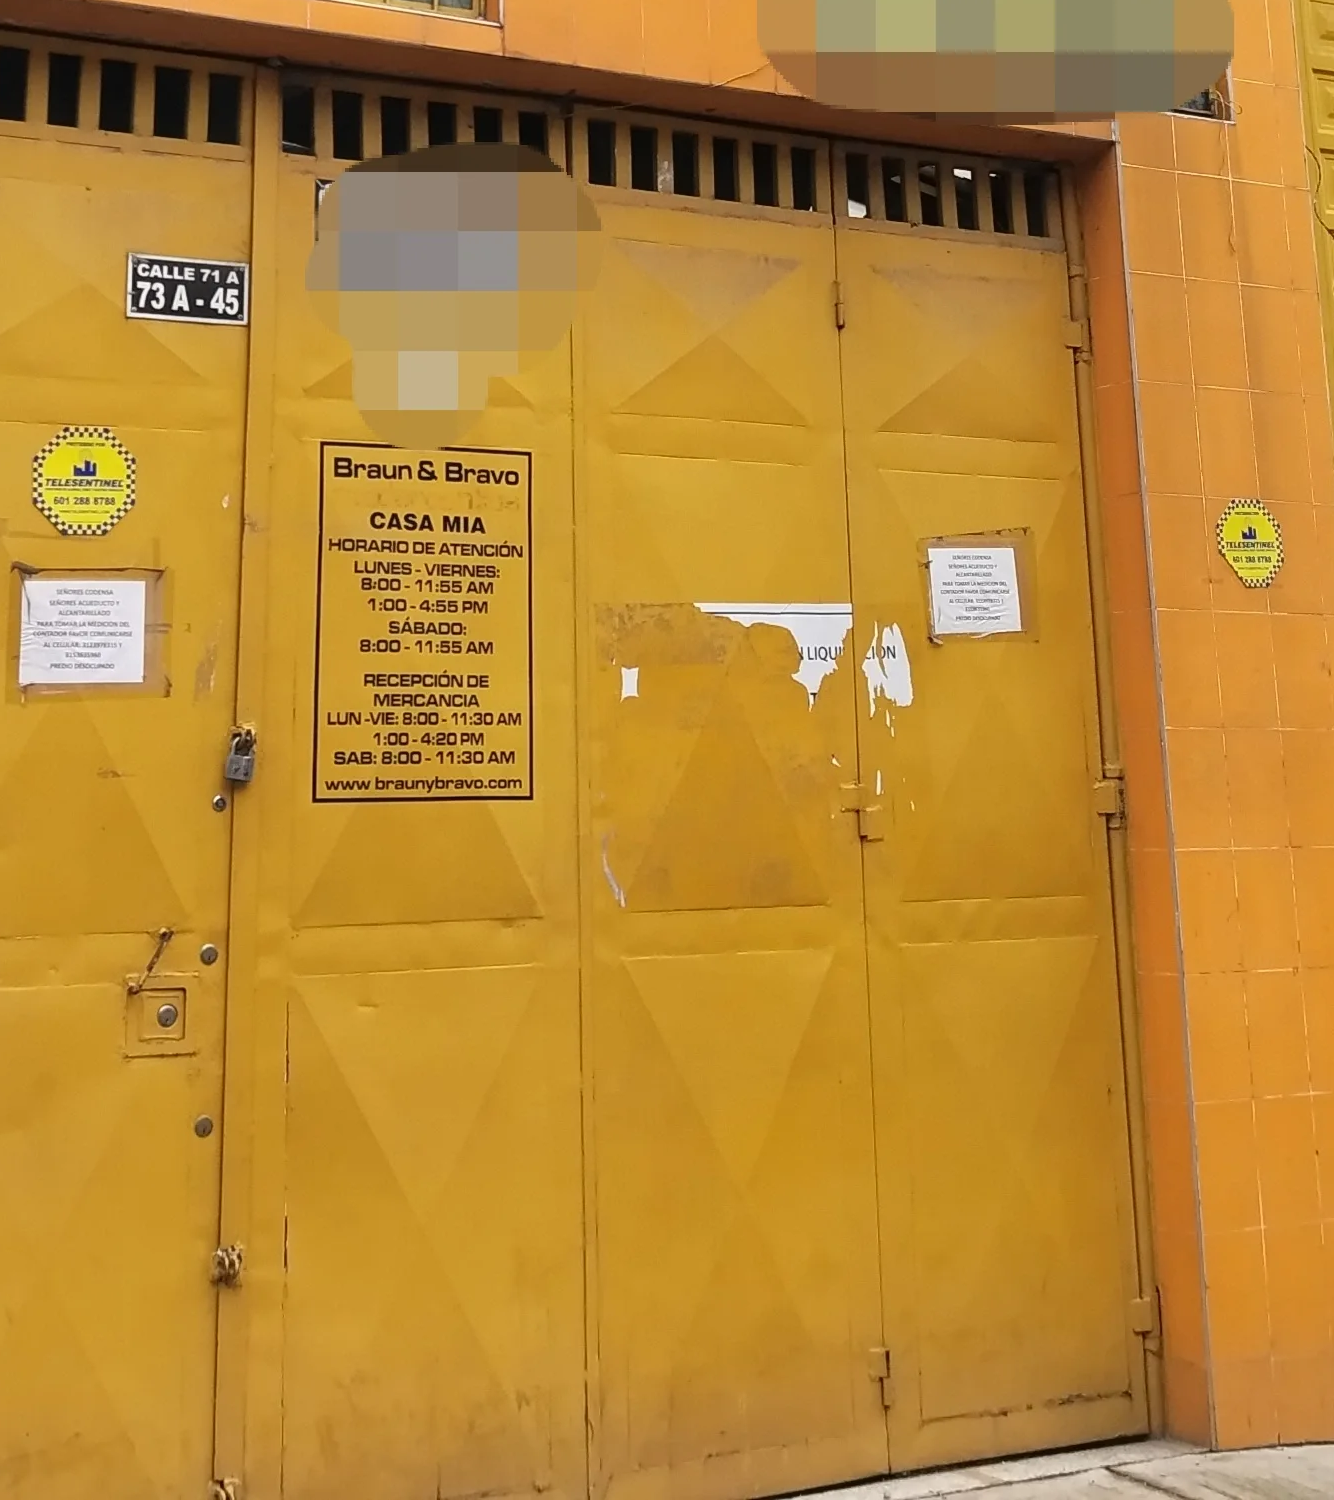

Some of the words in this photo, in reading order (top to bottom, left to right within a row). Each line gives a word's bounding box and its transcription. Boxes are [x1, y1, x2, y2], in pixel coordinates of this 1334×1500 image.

[137, 263, 195, 281] CALLE
[200, 268, 220, 283] 71
[226, 271, 240, 284] A
[136, 281, 165, 310] 73
[171, 284, 190, 312] A
[210, 287, 239, 315] 45
[334, 457, 412, 480] Braun
[417, 460, 438, 481] &
[445, 462, 520, 485] Bravo
[44, 478, 124, 487] TELESENTINEL
[370, 511, 434, 532] CASA
[442, 515, 486, 534] MIA
[328, 538, 409, 554] HORARIO
[413, 541, 435, 555] DE
[438, 540, 523, 558] ATENCIÓN
[354, 560, 412, 575] LUNES
[424, 563, 500, 578] VIERNES:
[361, 577, 401, 591] 8:00
[415, 580, 462, 593] 11:55
[466, 581, 494, 595] AM
[367, 598, 407, 612] 1:00
[419, 600, 458, 613] 4:55
[462, 601, 488, 614] PM
[388, 617, 467, 636] SÁBADO:
[360, 639, 401, 653] 8:00
[415, 640, 462, 654] 11:55
[466, 641, 494, 655] AM
[363, 670, 463, 688] RECEPCIÓN
[467, 675, 489, 688] DE
[374, 693, 480, 707] MERCANCIA
[327, 712, 362, 726] LUN
[402, 712, 439, 726] 8:00
[451, 713, 494, 726] 11:30
[496, 713, 522, 726] AM
[373, 732, 409, 746] 1:00
[421, 732, 457, 746] 4:20
[460, 732, 484, 746] PM
[334, 751, 377, 765] SAB:
[381, 751, 422, 765] 8:00
[435, 751, 484, 765] 11:30
[487, 751, 516, 765] AM
